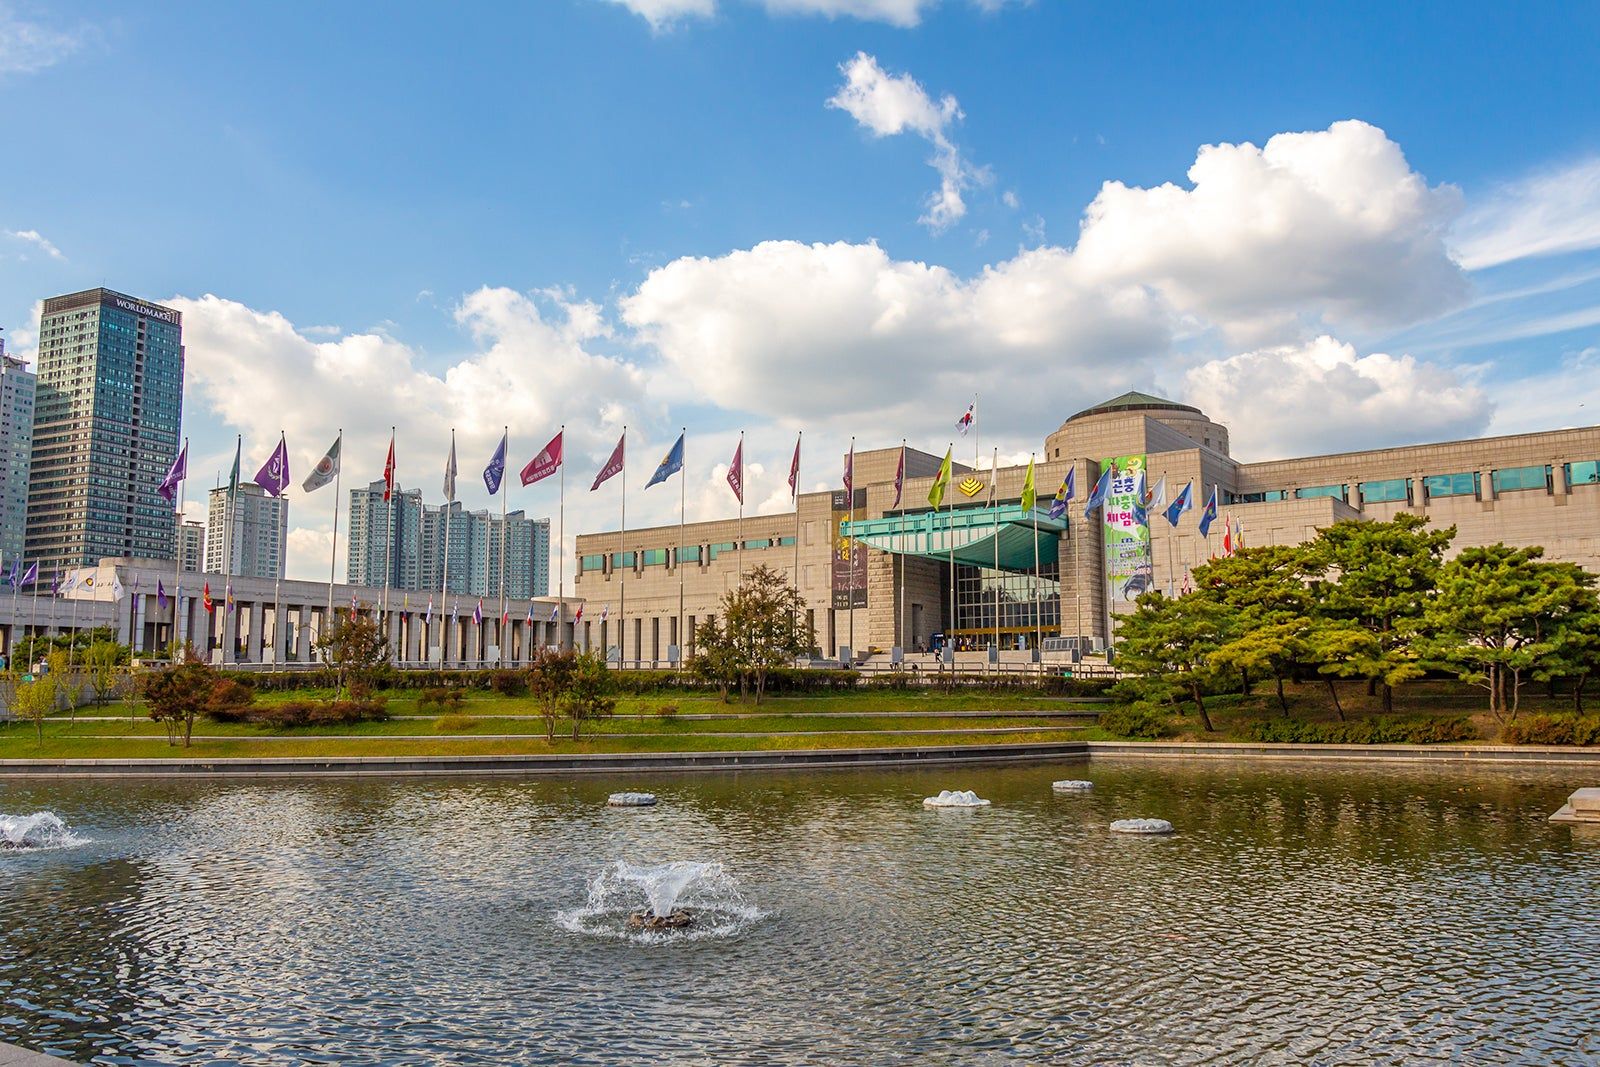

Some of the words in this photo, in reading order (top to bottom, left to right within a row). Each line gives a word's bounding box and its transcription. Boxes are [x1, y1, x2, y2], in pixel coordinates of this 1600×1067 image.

[116, 299, 171, 322] WORLDMARK
[1112, 477, 1135, 494] 곤충
[1108, 495, 1137, 511] 파충
[1107, 511, 1140, 526] 체험
